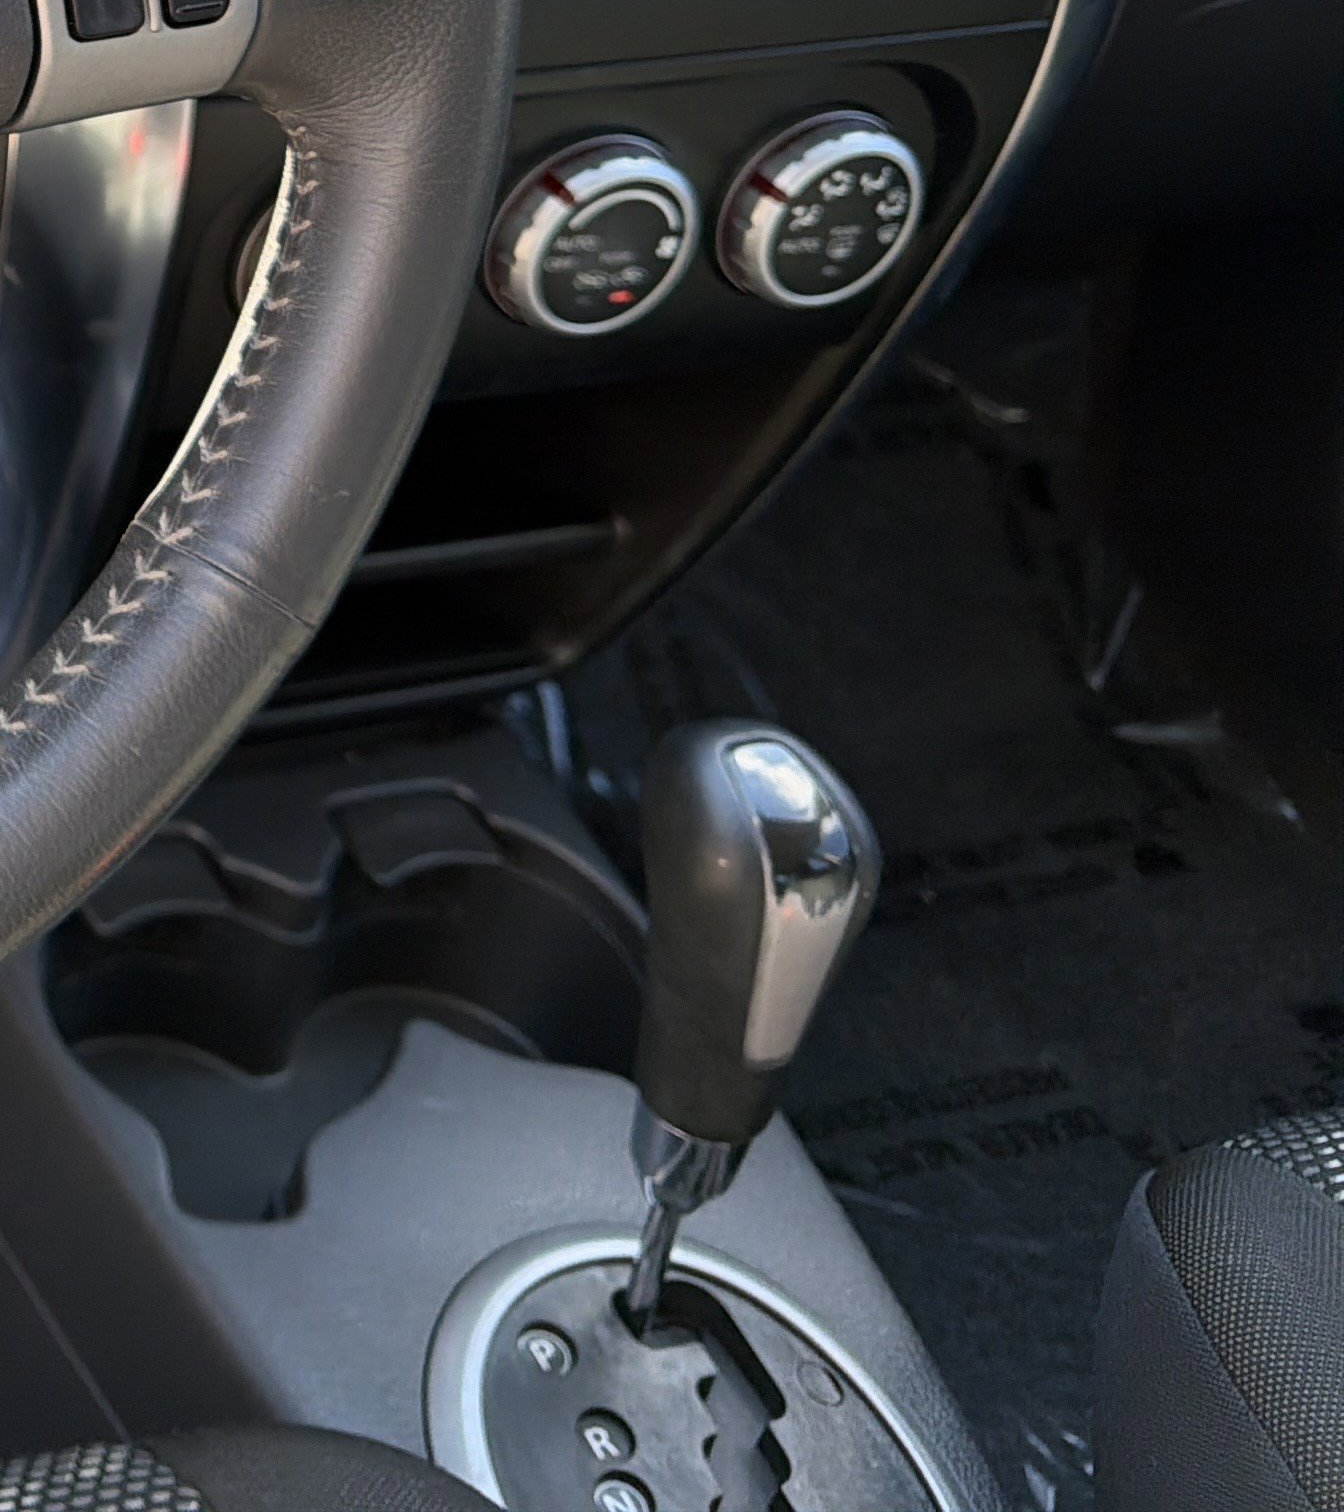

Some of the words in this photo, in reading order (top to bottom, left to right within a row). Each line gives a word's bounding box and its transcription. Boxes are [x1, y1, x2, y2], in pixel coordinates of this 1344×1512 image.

[527, 1340, 556, 1373] P
[583, 1426, 621, 1460] R
[602, 1489, 639, 1512] N
